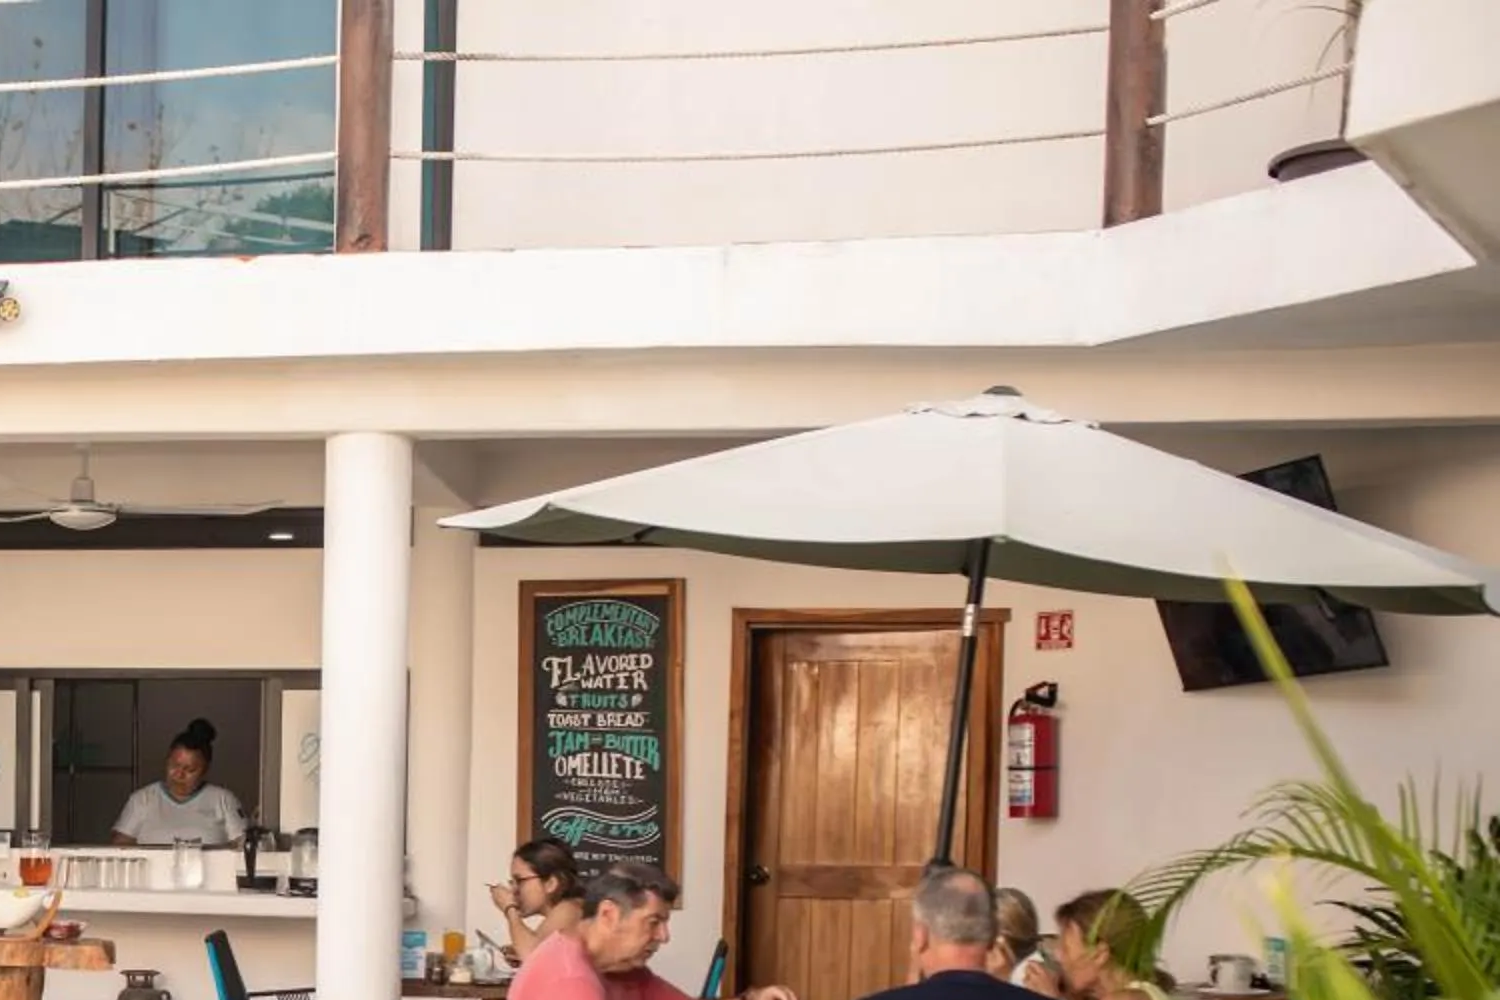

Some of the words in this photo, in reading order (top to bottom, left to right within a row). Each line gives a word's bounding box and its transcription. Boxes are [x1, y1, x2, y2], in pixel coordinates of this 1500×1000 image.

[557, 622, 651, 648] BREAKFAST
[542, 653, 653, 689] FLAVORED
[581, 670, 649, 690] WATER
[569, 693, 628, 708] FRUITS
[548, 713, 591, 729] TOAST
[597, 712, 645, 728] BREAD
[548, 730, 590, 758] JAM
